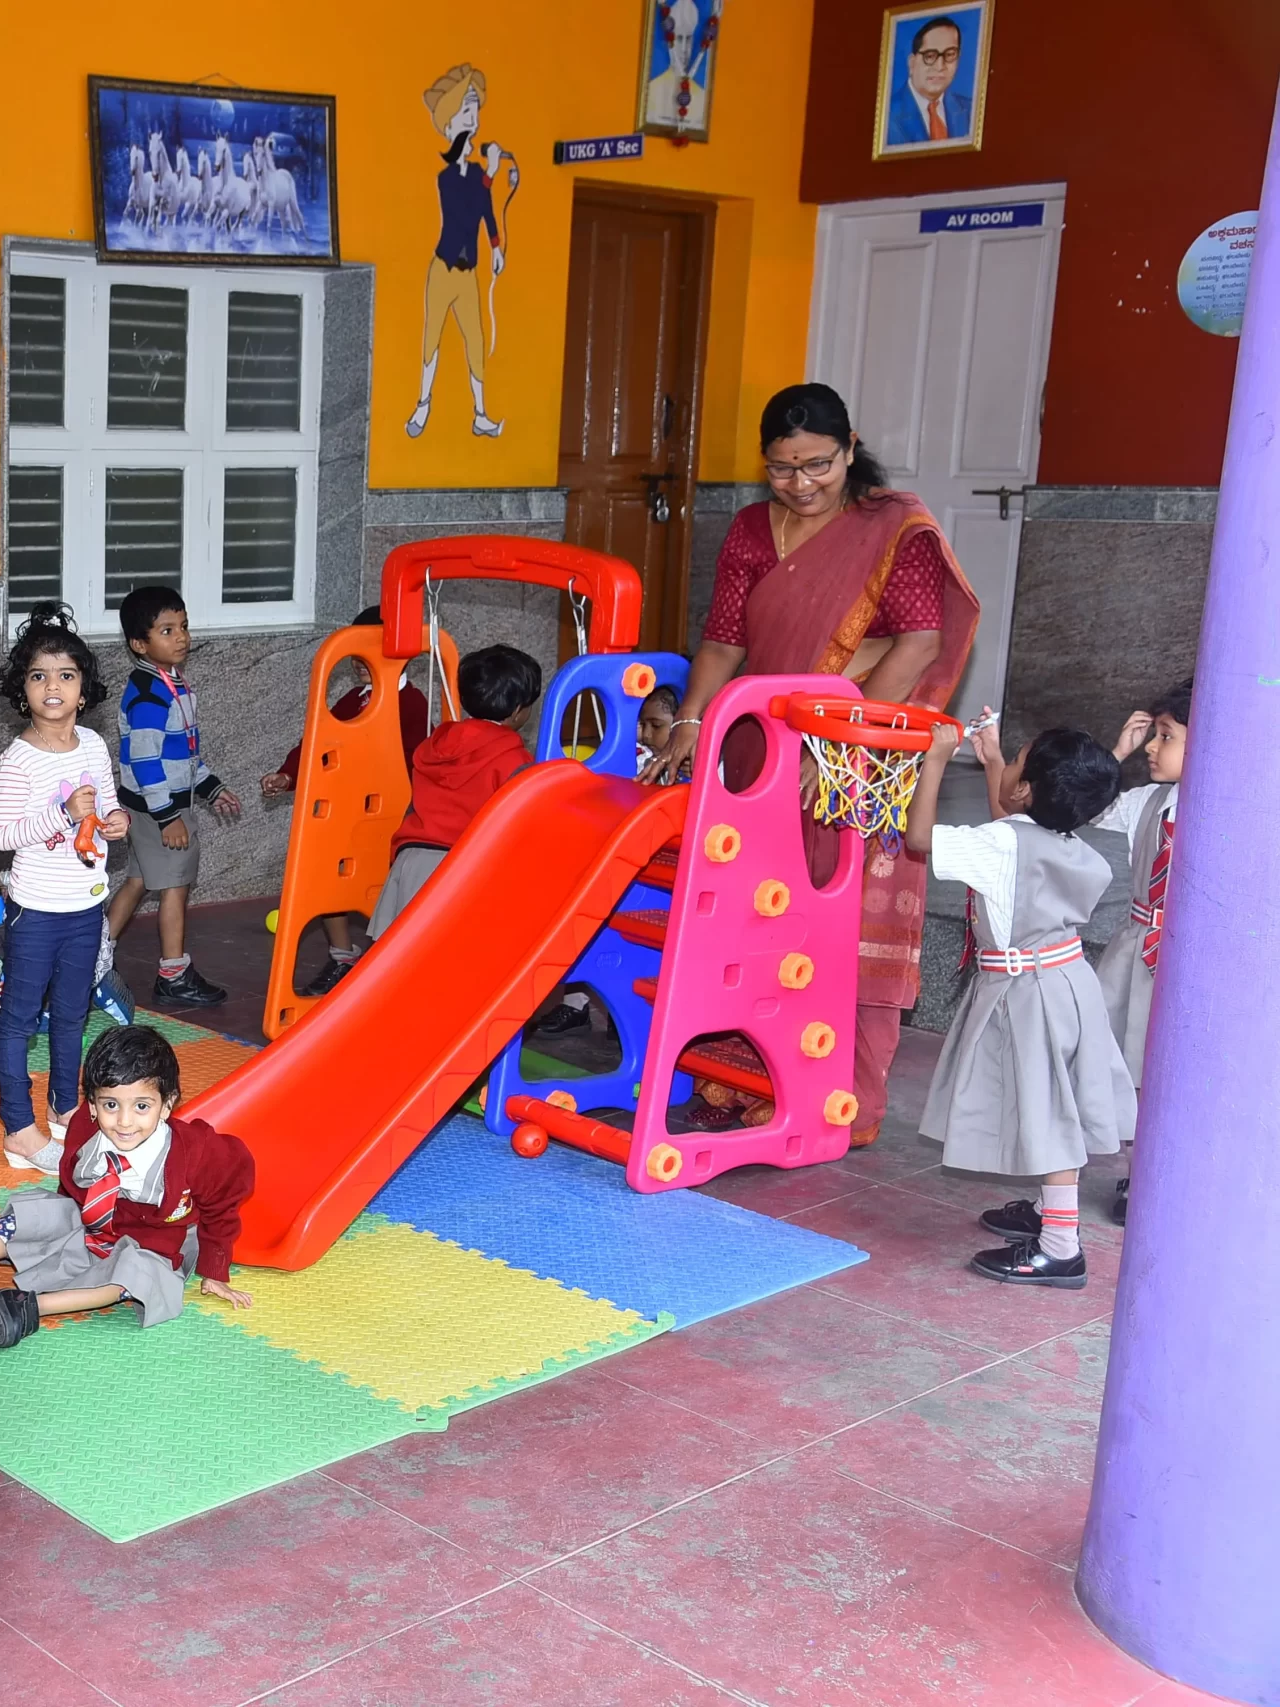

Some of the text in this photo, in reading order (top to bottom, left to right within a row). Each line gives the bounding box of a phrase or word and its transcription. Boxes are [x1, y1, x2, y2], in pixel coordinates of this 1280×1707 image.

[569, 143, 596, 159] UKG
[616, 140, 639, 155] Sec
[946, 211, 1014, 227] AV ROOM
